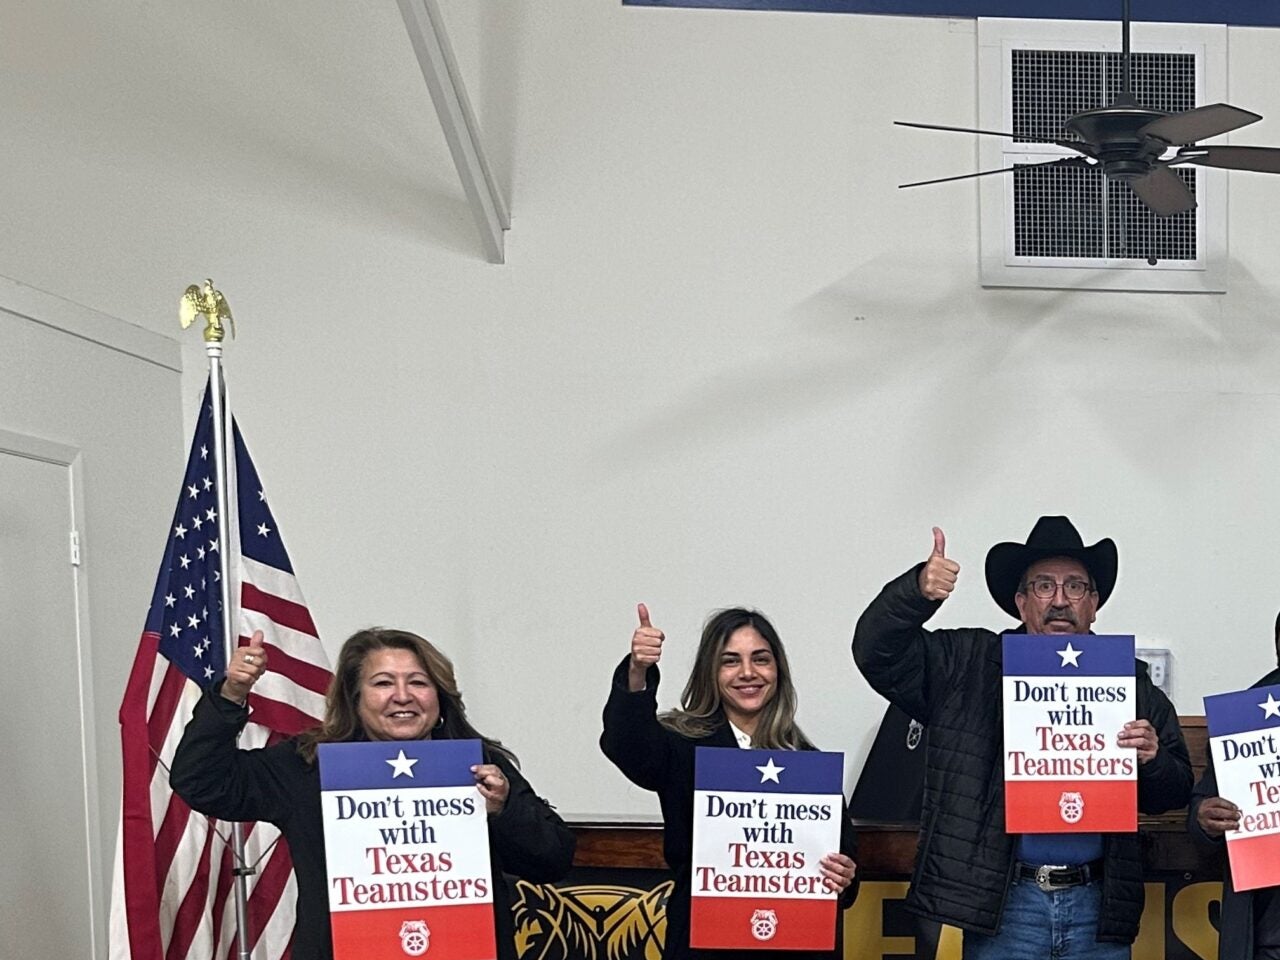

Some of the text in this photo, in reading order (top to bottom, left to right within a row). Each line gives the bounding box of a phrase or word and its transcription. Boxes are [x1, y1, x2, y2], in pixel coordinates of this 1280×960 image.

[1013, 680, 1127, 703] Don't mess
[1046, 704, 1094, 727] with
[1035, 726, 1106, 752] Texas
[1221, 732, 1278, 762] Don't
[1008, 751, 1134, 776] Teamsters
[335, 794, 476, 821] Don't mess
[705, 794, 832, 821] Don't mess
[378, 819, 438, 845] with
[742, 821, 794, 844] with
[365, 846, 453, 876] Texas
[728, 842, 806, 869] Texas
[332, 874, 489, 906] Teamsters
[696, 866, 834, 895] Teamsters
